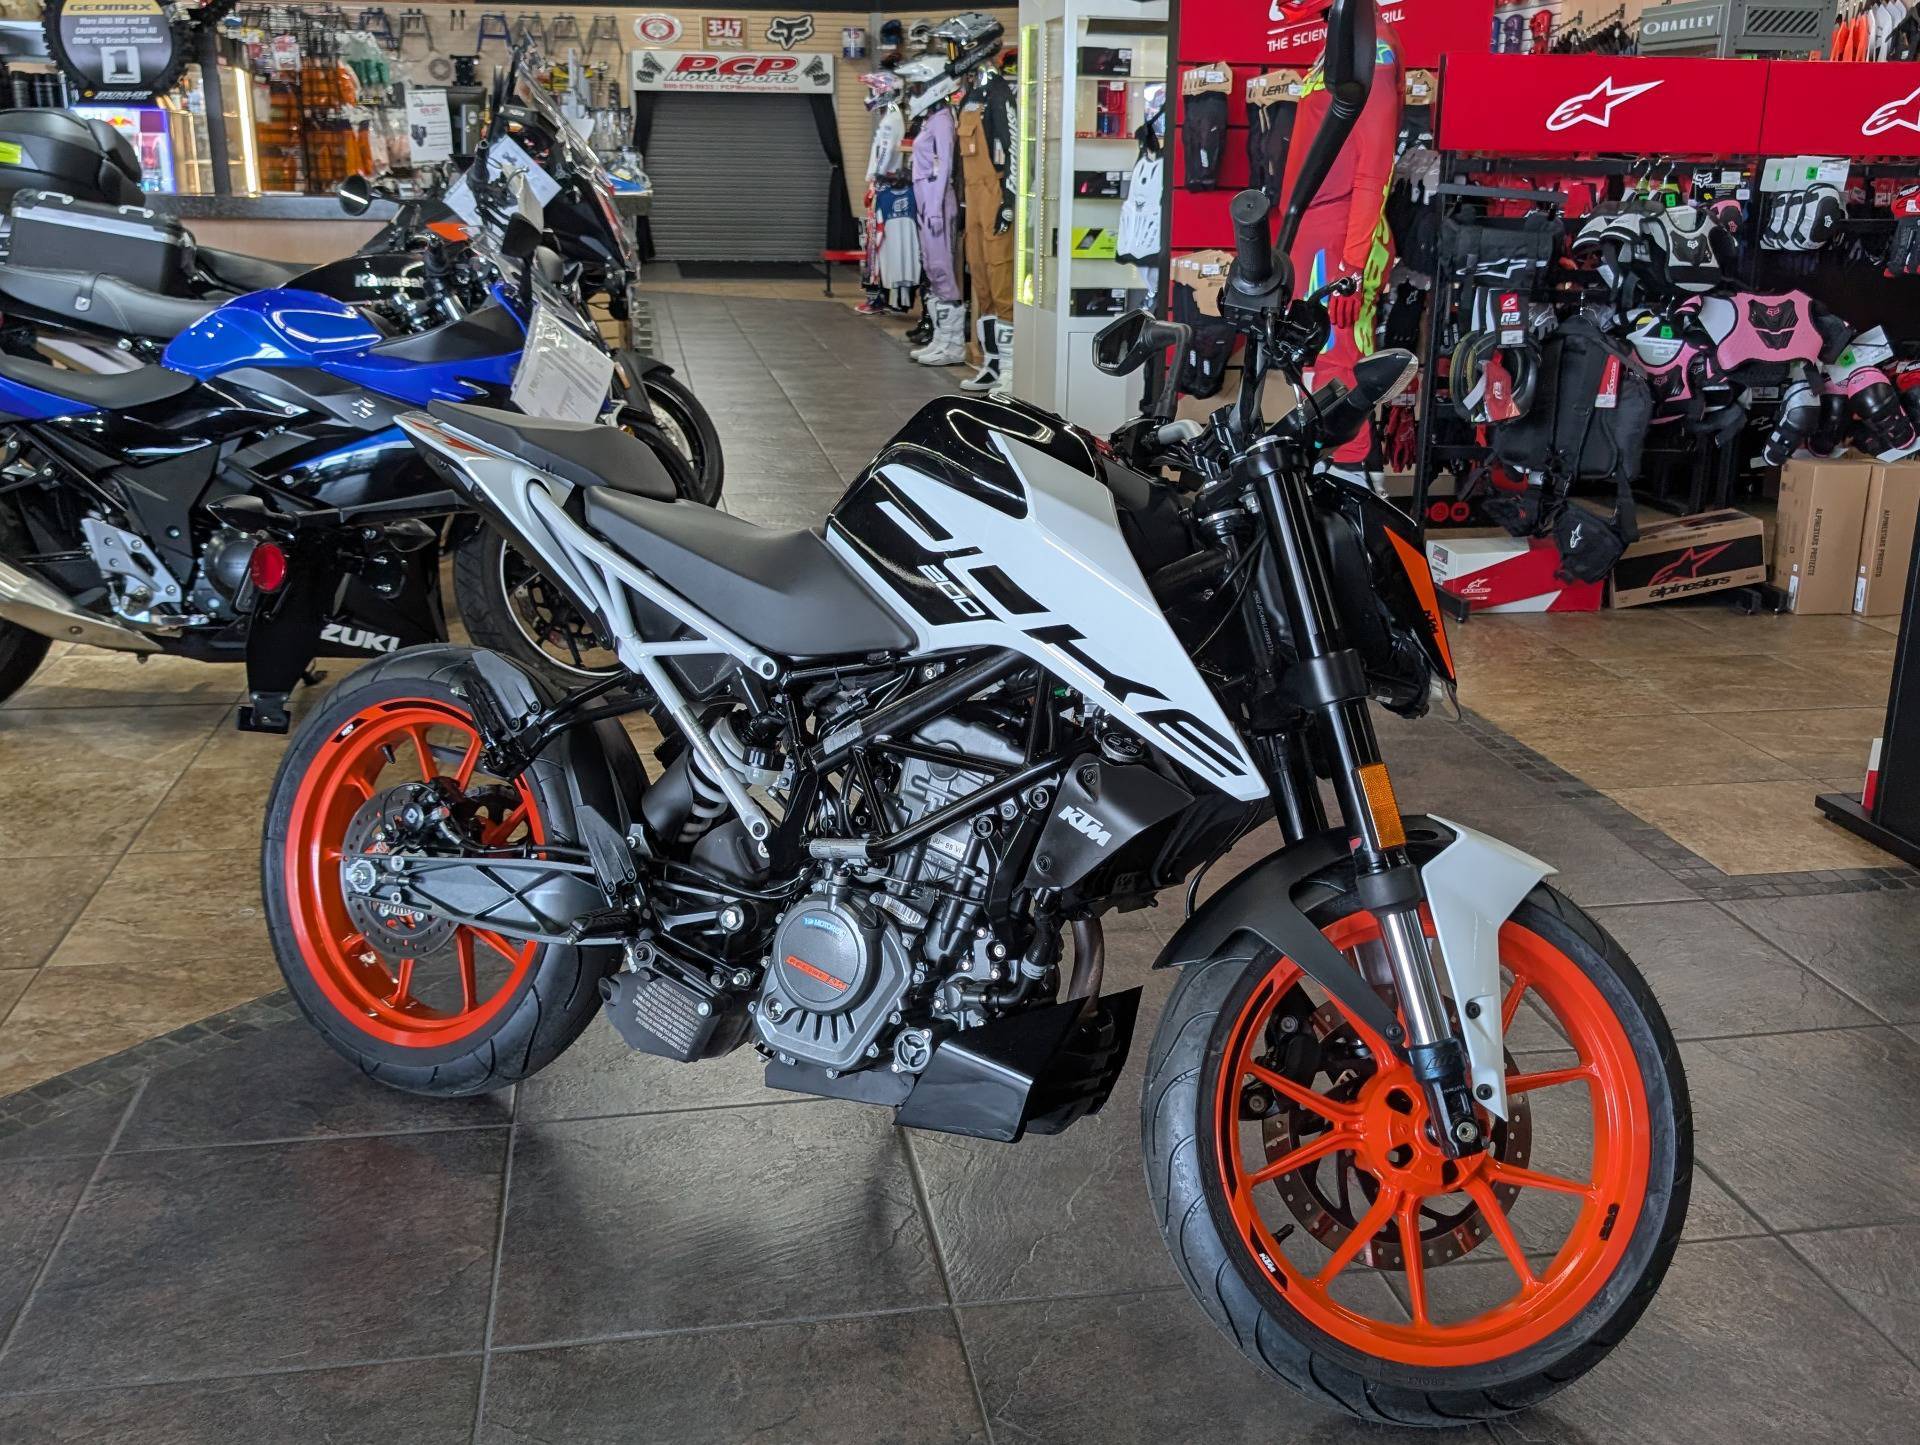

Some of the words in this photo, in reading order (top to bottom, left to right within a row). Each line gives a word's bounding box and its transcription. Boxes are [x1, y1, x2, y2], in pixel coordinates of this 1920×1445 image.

[1267, 37, 1289, 52] THE
[1292, 27, 1328, 47] SCIEN
[1381, 9, 1405, 24] RILL
[1643, 15, 1714, 35] OAKLEY
[675, 54, 799, 76] PCP
[663, 70, 800, 84] Motorsports
[1262, 82, 1291, 97] LEAT
[355, 274, 424, 288] Kawasa
[1501, 311, 1520, 323] R3
[917, 564, 986, 617] 200
[1650, 576, 1732, 598] alpinestars
[320, 623, 401, 653] ZUKI
[1057, 805, 1113, 847] KTM
